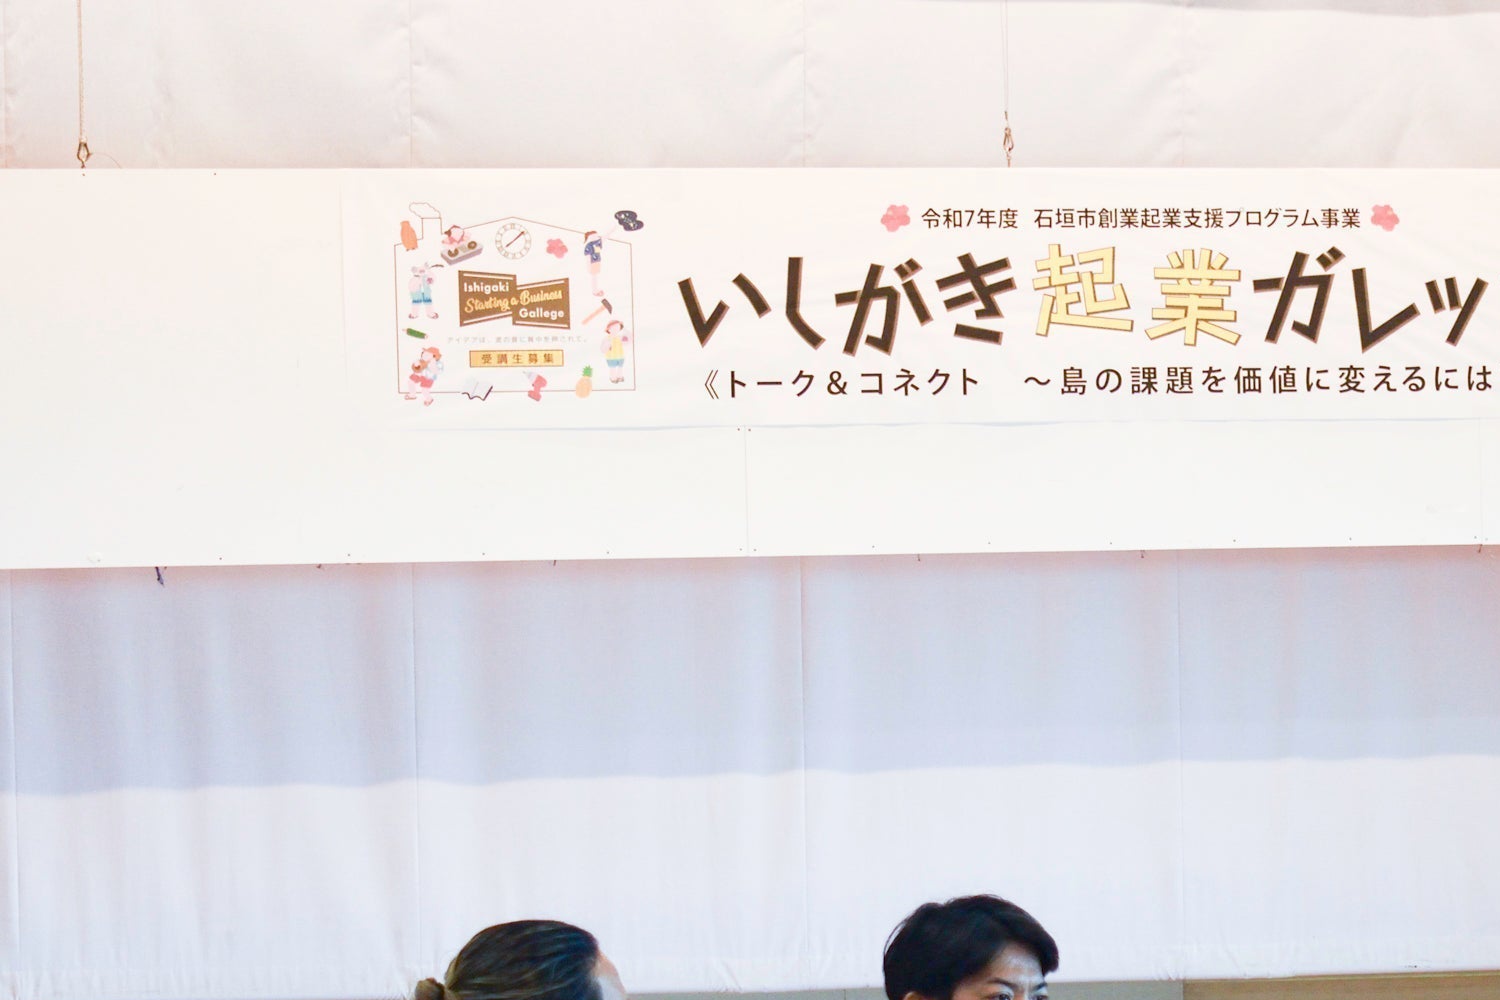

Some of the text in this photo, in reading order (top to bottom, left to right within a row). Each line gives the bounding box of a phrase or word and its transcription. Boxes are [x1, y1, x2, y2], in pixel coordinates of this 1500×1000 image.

[921, 207, 1362, 230] 令和7年度 石垣市創業起業支援プログラム事業
[463, 282, 509, 295] Ishigaki
[464, 297, 510, 313] Starting
[519, 290, 562, 305] Business
[518, 308, 565, 320] Gallege
[481, 353, 554, 364] 受講生募集
